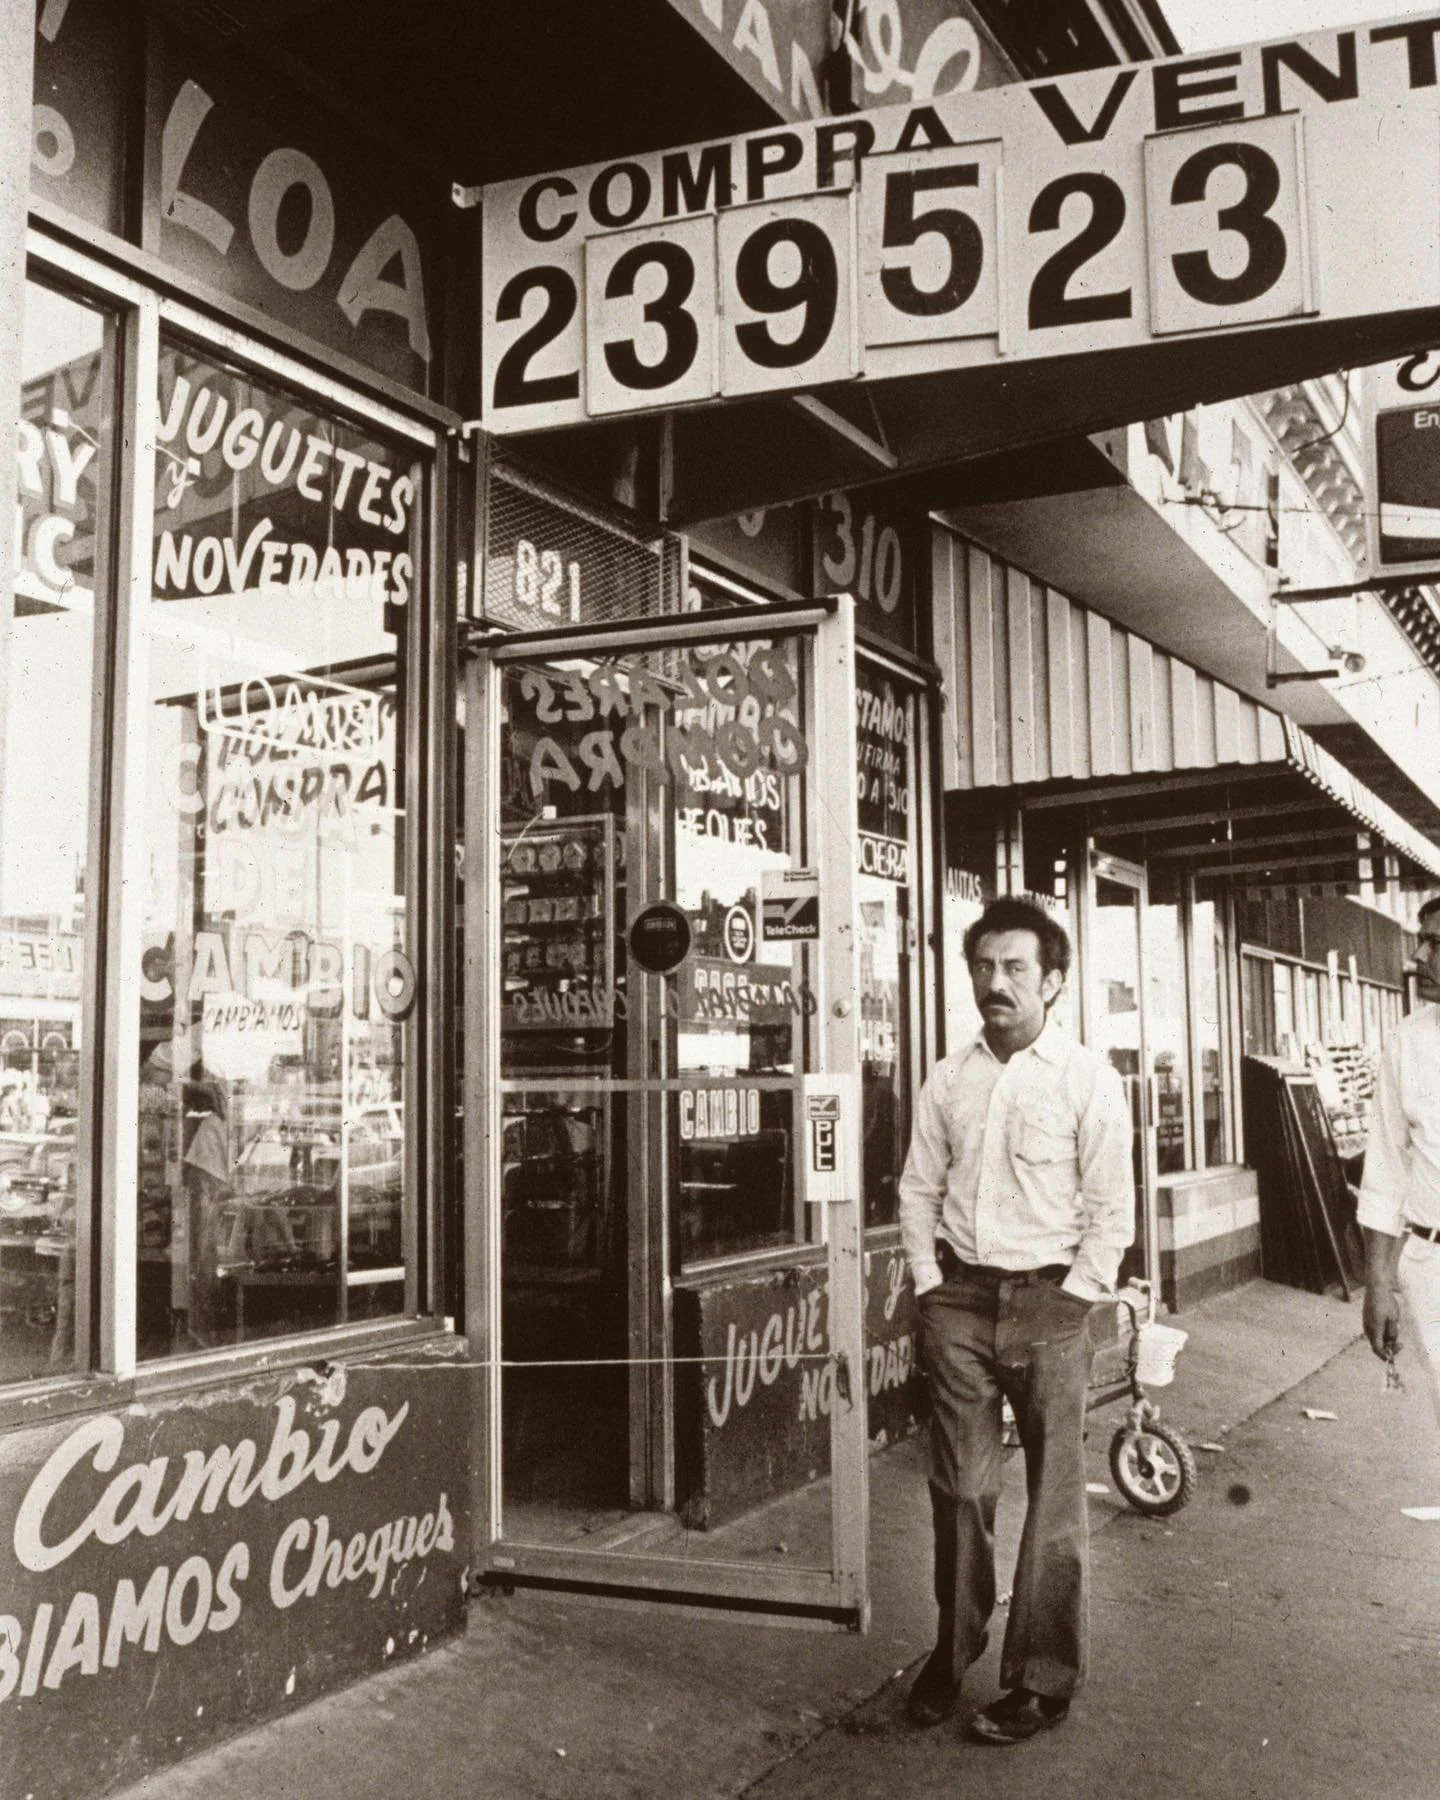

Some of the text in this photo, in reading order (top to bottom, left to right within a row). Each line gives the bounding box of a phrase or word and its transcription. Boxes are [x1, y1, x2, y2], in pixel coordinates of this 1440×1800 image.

[519, 106, 956, 242] COMPRA
[156, 376, 414, 535] JUGUETES
[154, 517, 414, 606] NOVEDADES
[140, 930, 417, 1022] CAMBIO
[765, 924, 817, 936] TeleCheck
[681, 1089, 760, 1140] CAMBIO
[14, 1397, 410, 1572] Cambio
[270, 1493, 455, 1611] Cheques
